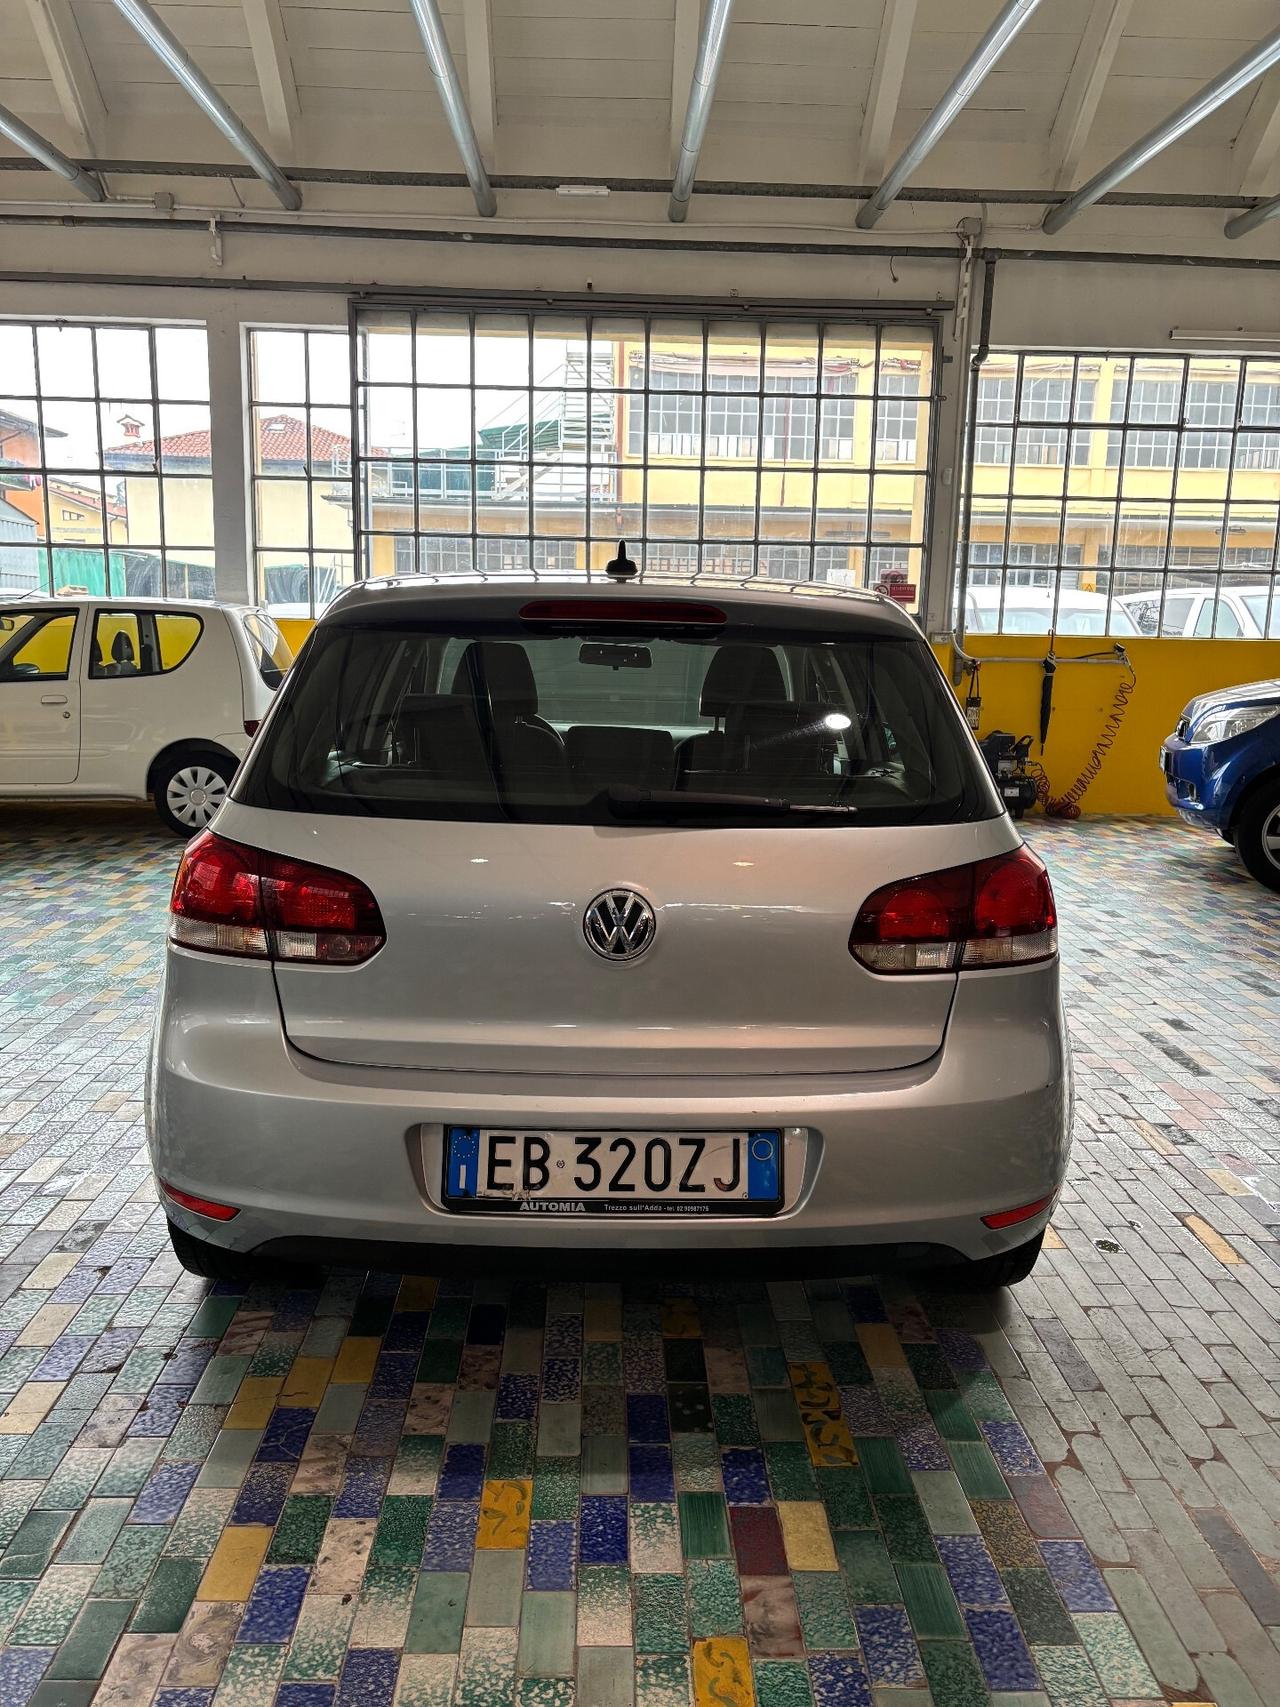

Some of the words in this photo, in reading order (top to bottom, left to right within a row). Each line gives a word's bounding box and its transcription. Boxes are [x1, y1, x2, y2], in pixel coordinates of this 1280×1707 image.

[486, 1135, 551, 1191] EB
[573, 1137, 741, 1193] 320ZJ
[519, 1201, 586, 1212] AUTOMIA
[603, 1203, 628, 1212] Trezzo
